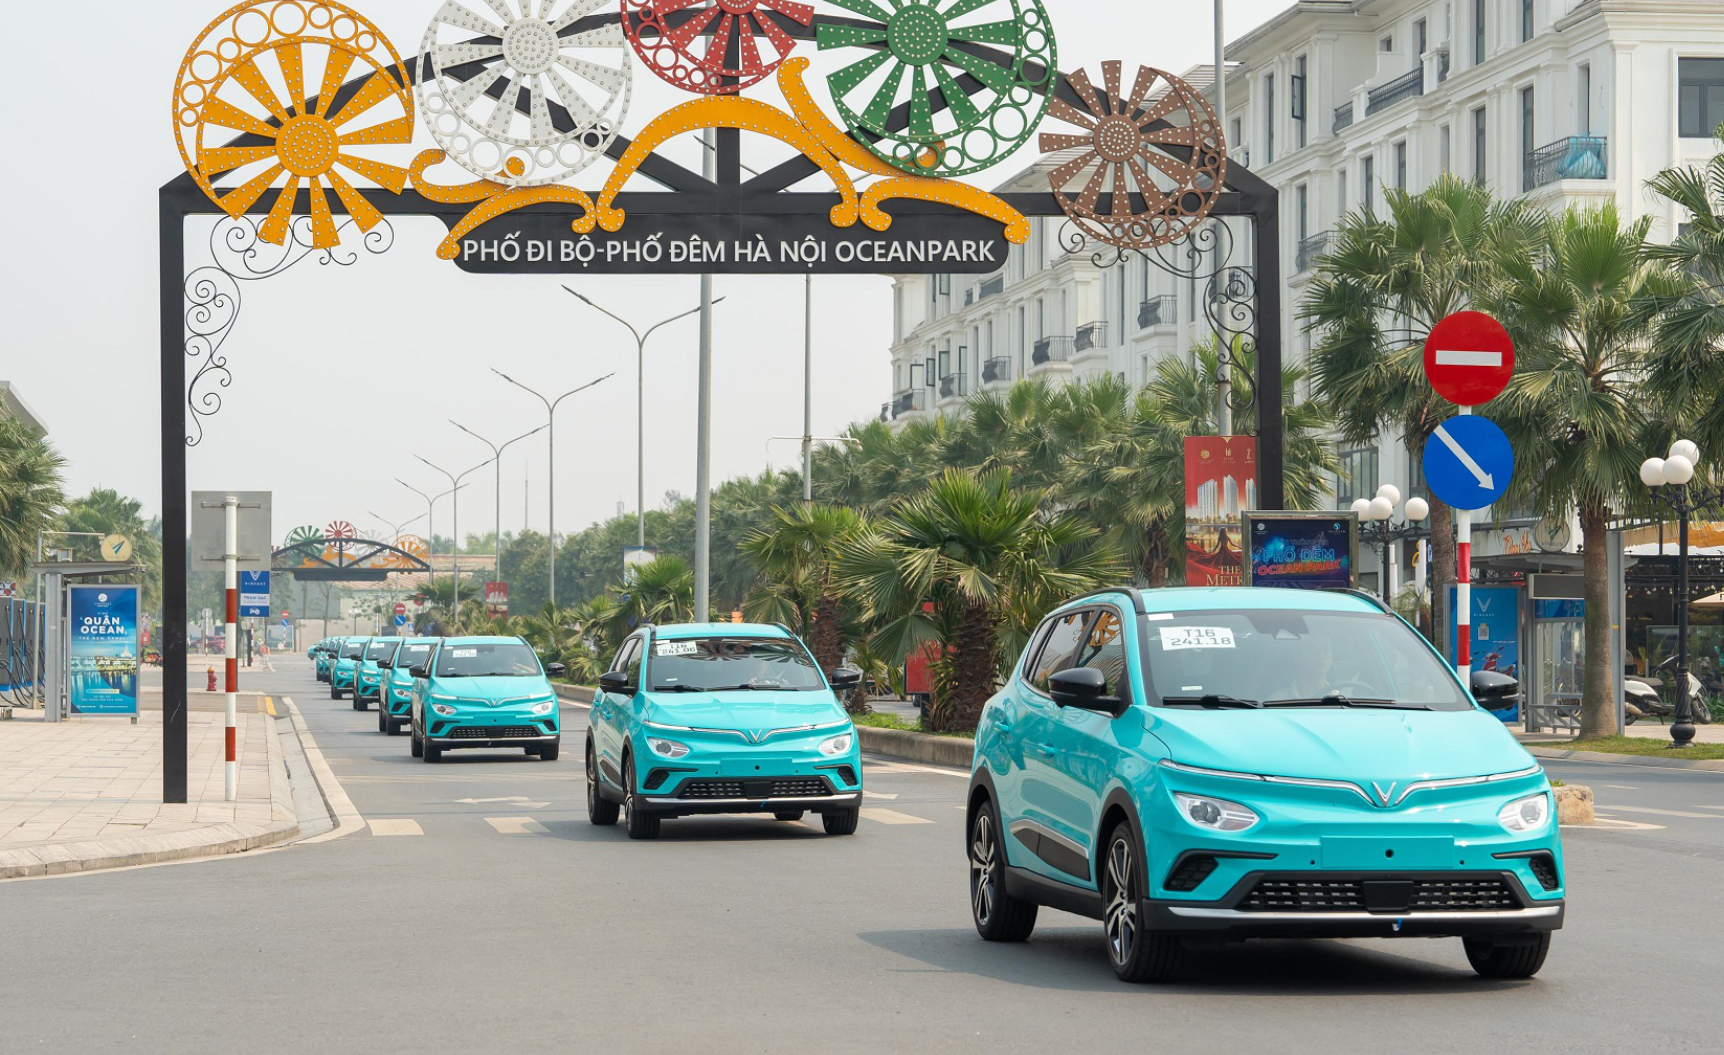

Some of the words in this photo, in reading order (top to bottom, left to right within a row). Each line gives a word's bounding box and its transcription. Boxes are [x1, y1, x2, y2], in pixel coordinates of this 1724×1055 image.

[464, 230, 521, 262] PHỐ
[526, 240, 552, 262] ĐI
[560, 232, 663, 268] BỘ-PHỐ
[669, 234, 726, 263] ĐÊM
[734, 234, 772, 262] HÀ
[780, 234, 826, 268] NỘI
[835, 240, 996, 263] OCEANPARK
[1263, 545, 1296, 563] PHỐ
[1300, 545, 1335, 563] ĐÊM
[1218, 565, 1242, 575] THE
[1257, 562, 1303, 576] OCEAN
[1305, 559, 1342, 572] PARK
[1205, 573, 1243, 587] METR
[1183, 628, 1216, 638] T16
[1171, 637, 1231, 647] 241.18
